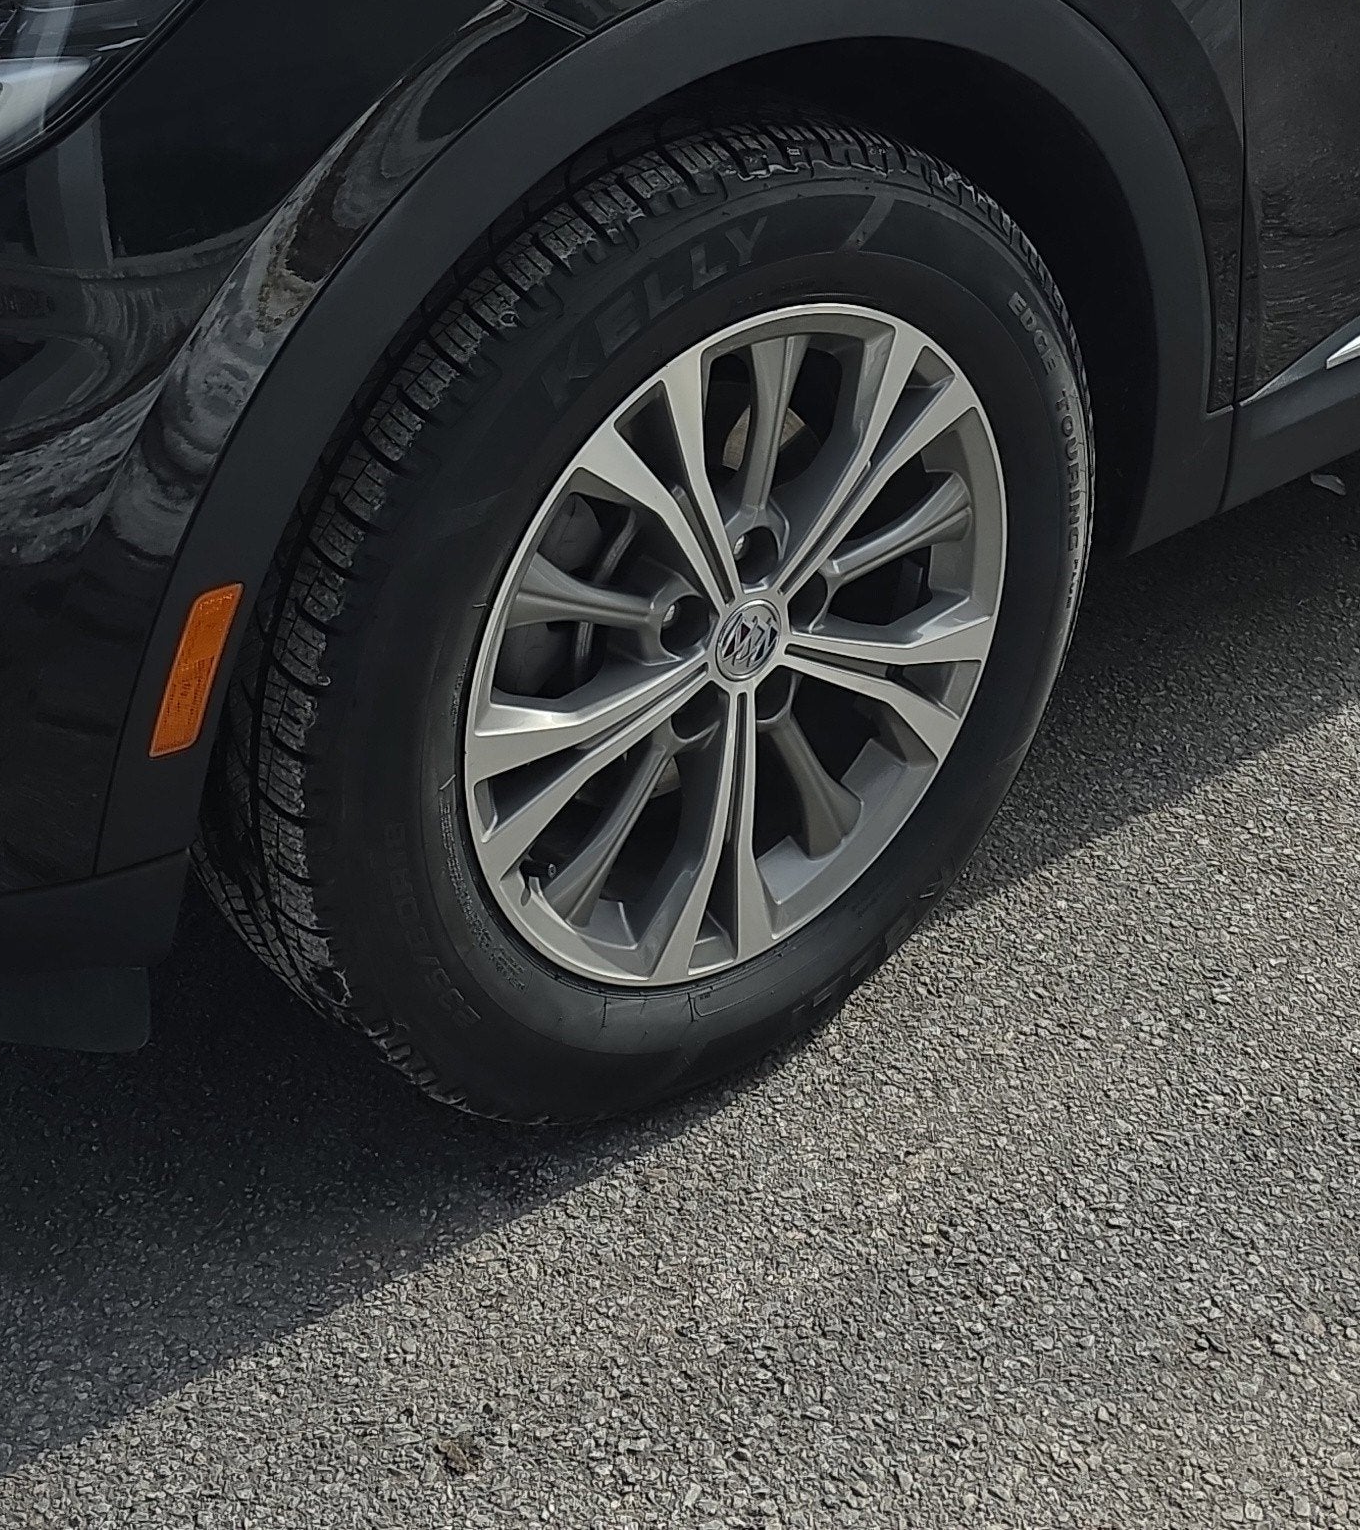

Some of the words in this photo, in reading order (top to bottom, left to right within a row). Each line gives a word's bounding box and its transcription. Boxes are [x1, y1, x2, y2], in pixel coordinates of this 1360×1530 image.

[539, 215, 769, 414] KELLY
[1006, 290, 1059, 378] EDGE
[1054, 386, 1083, 555] TOURING
